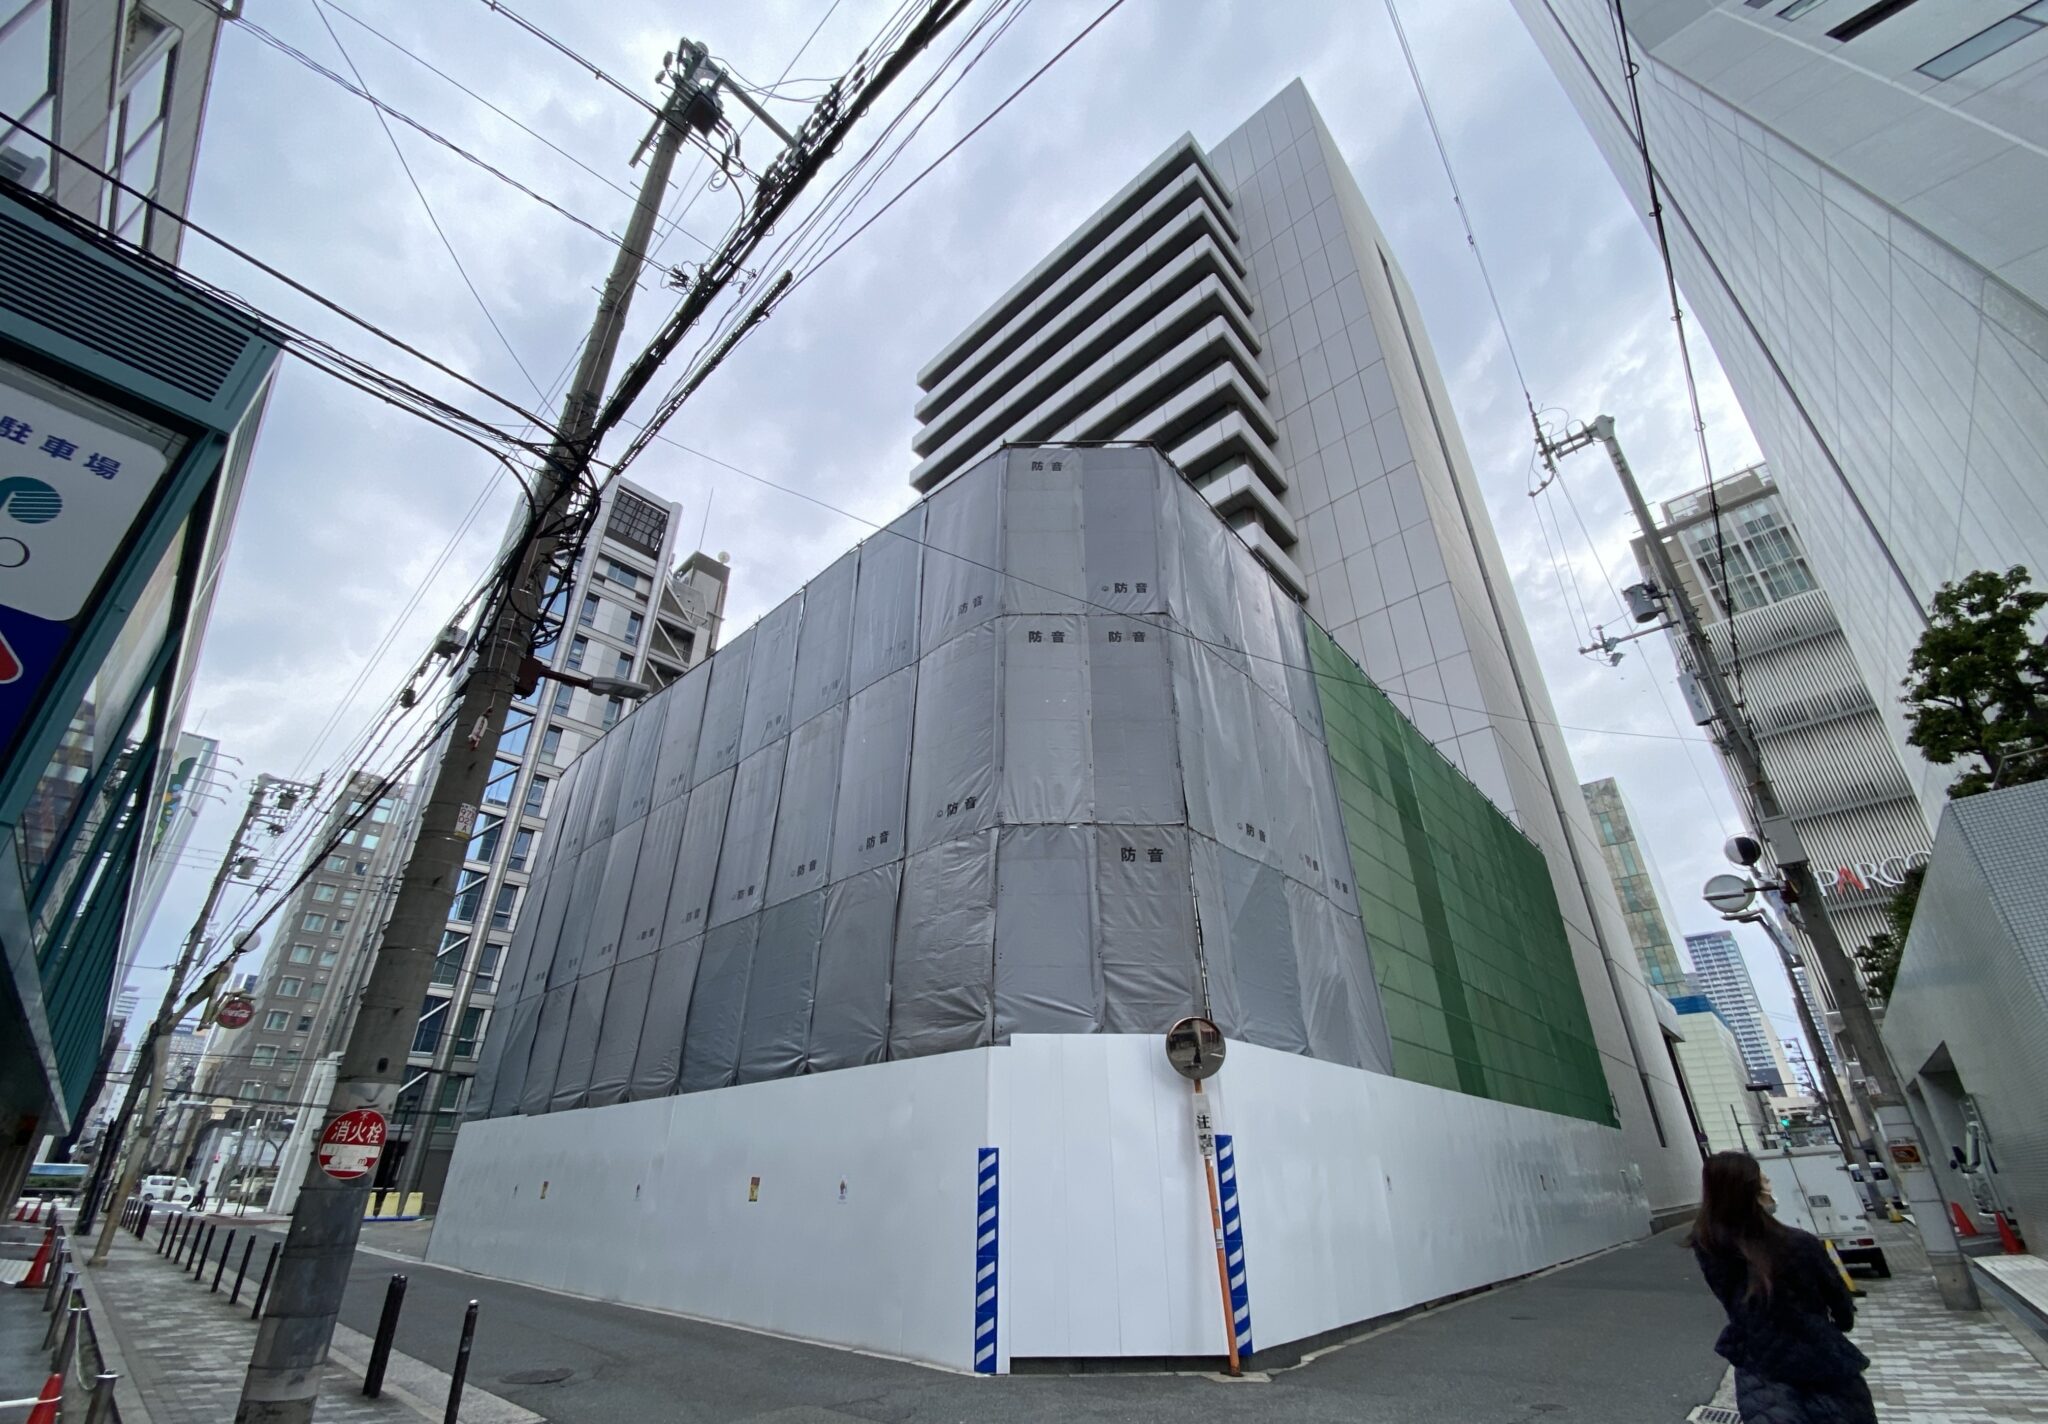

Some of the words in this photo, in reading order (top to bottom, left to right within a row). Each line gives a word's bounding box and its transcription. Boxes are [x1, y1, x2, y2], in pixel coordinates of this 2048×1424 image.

[0, 416, 121, 480] 駐車場
[1031, 461, 1063, 472] 防音
[1114, 582, 1148, 594] 防音
[958, 595, 983, 616] 防音
[1028, 631, 1065, 643] 防音
[1108, 631, 1146, 643] 防音
[947, 796, 977, 817] 防音
[866, 830, 888, 850] 防音
[1121, 847, 1164, 863] 防音
[331, 1120, 383, 1144] 消火栓
